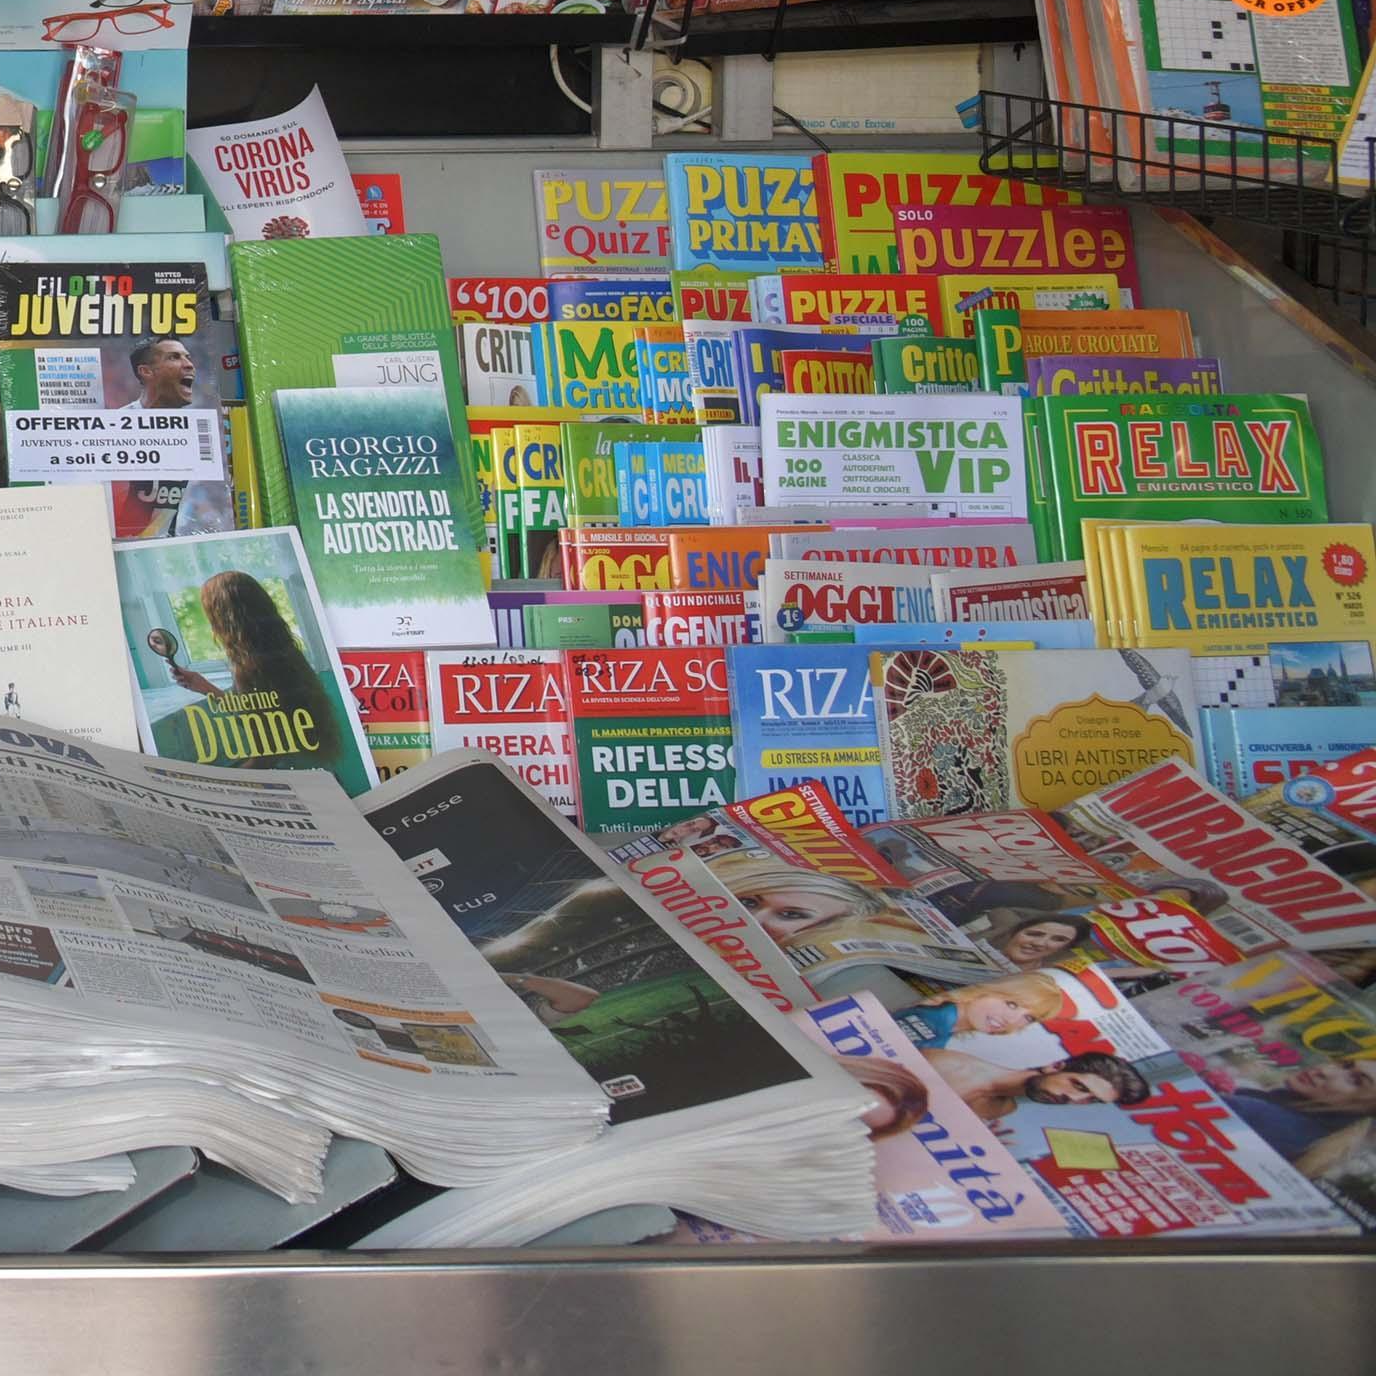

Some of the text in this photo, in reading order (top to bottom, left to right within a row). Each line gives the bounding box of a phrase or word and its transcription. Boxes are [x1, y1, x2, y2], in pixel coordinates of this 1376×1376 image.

[214, 127, 315, 173] CORONA
[235, 162, 311, 199] VIRUS
[11, 293, 197, 335] JUVENTUS
[16, 416, 188, 431] OFFERTA 2 LIBRI
[776, 419, 1007, 451] ENIGMISTICA
[50, 450, 160, 464] a soli € 9.90
[305, 434, 437, 458] GIORGIO
[1075, 420, 1302, 493] RELAX
[310, 456, 441, 478] RAGAZZI
[913, 449, 1011, 493] VIP
[323, 519, 458, 554] AUTOSTRADE
[206, 688, 279, 717] Catherine
[185, 705, 320, 765] Dunne
[1106, 763, 1376, 935] MIRACOLI
